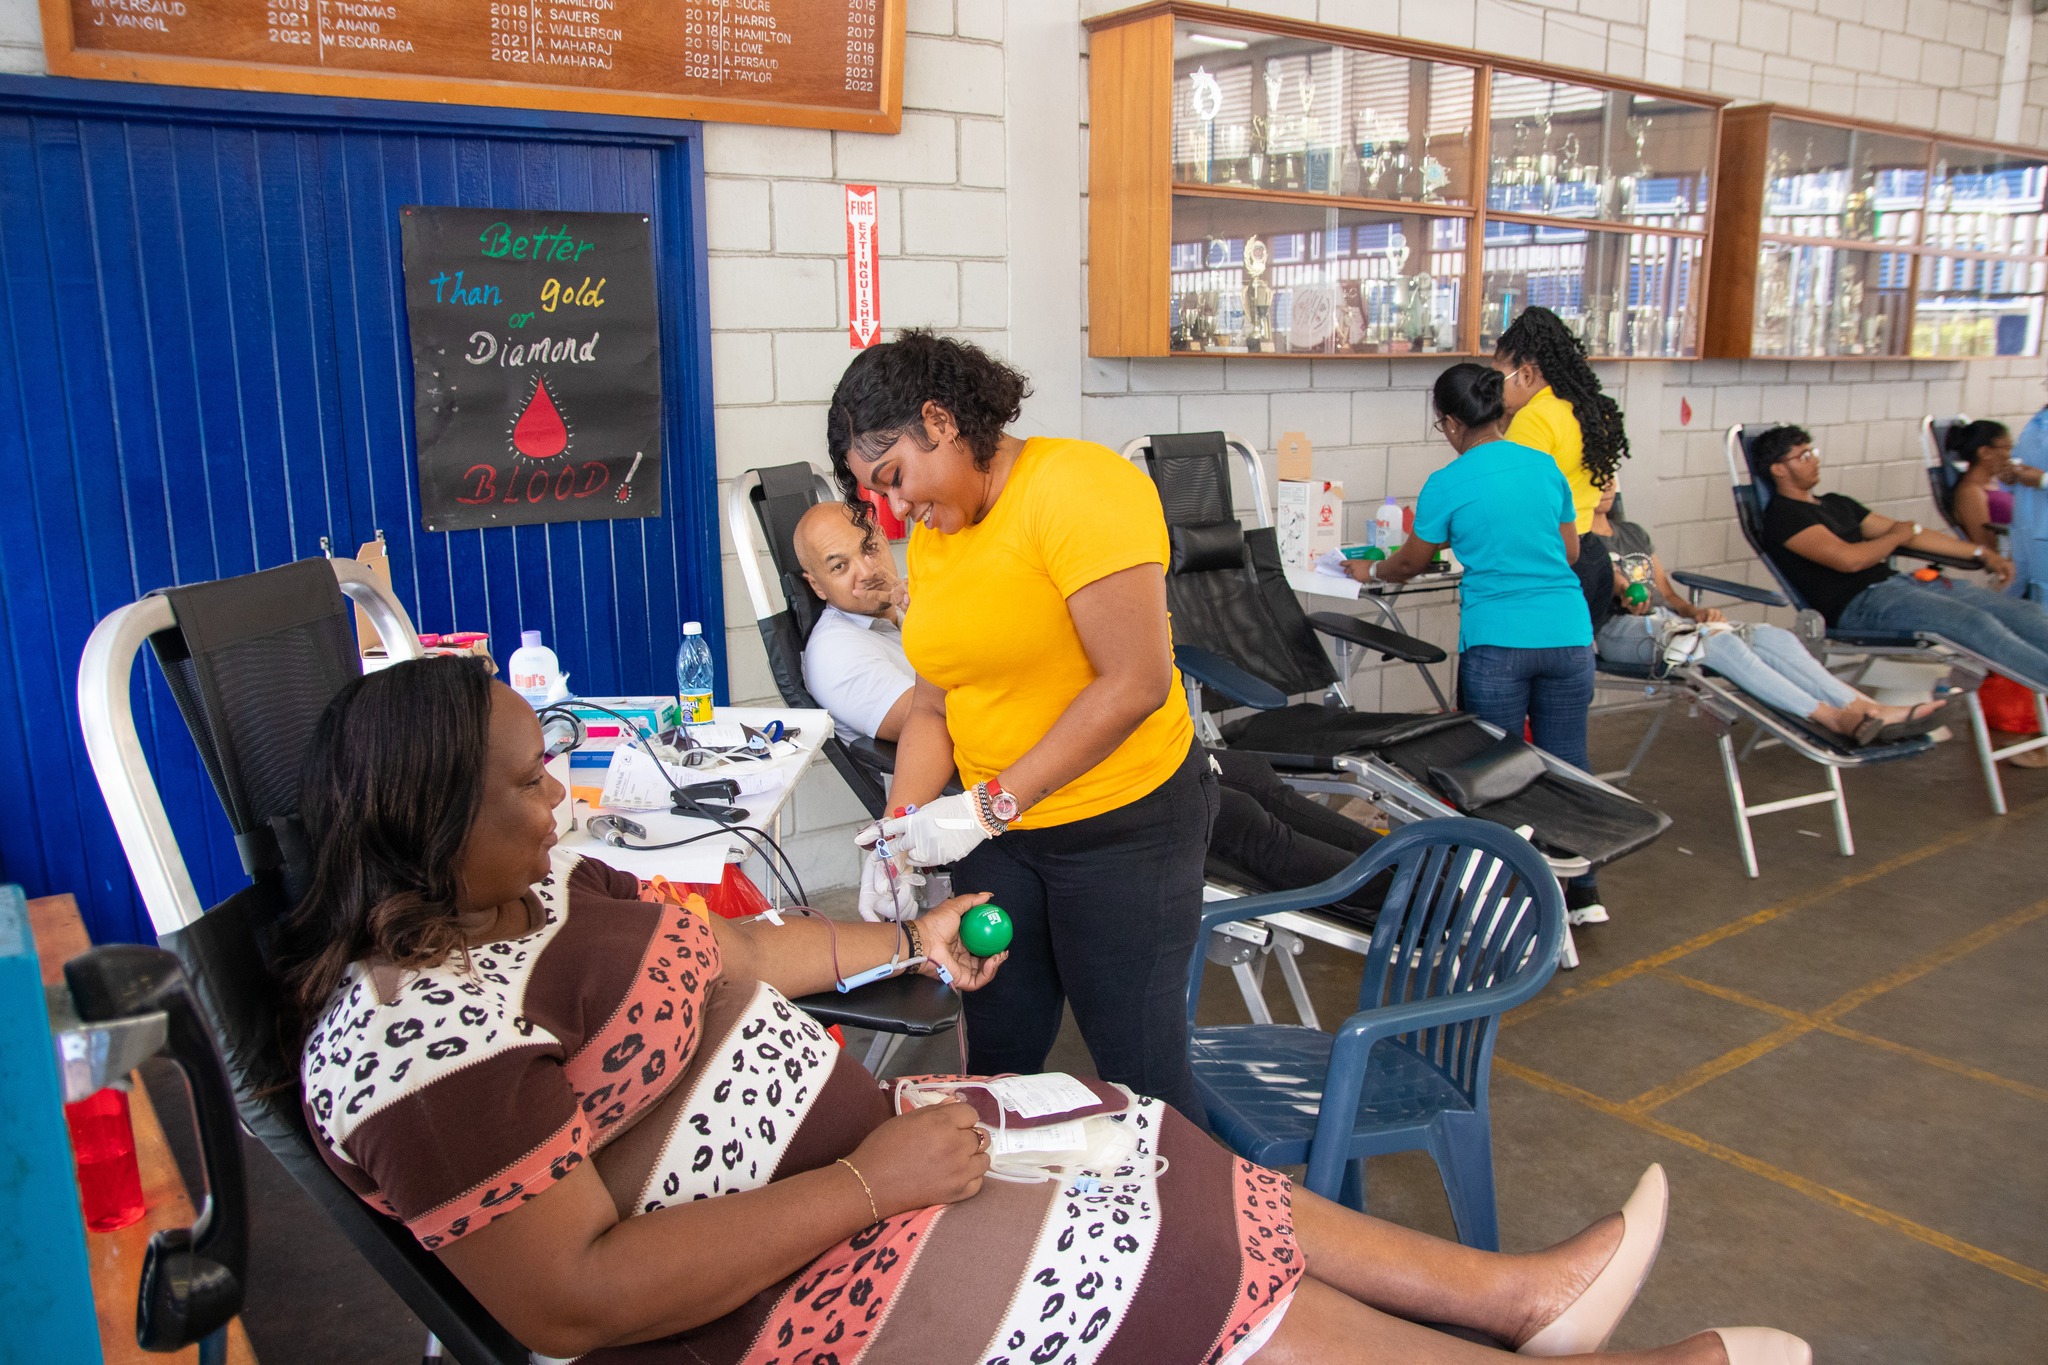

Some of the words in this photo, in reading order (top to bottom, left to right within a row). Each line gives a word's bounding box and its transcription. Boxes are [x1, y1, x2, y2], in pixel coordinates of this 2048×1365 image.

[491, 3, 528, 17] 2018
[848, 0, 876, 11] 2015
[267, 11, 309, 27] 2021
[685, 9, 720, 22] 2017
[848, 12, 875, 26] 2016
[491, 18, 527, 32] 2019
[685, 23, 719, 37] 2018
[268, 28, 311, 45] 2022
[847, 26, 875, 39] 2017
[491, 33, 528, 47] 2021
[685, 37, 719, 51] 2019
[847, 40, 875, 54] 2018
[491, 48, 529, 63] 2022
[685, 51, 718, 65] 2021
[846, 53, 875, 66] 2019
[685, 65, 719, 79] 2022
[846, 67, 873, 79] 2021
[845, 79, 873, 92] 2022
[851, 200, 873, 216] FIRE
[479, 221, 595, 262] Better
[858, 221, 870, 337] EXTINGUISHER
[541, 276, 607, 312] gold
[508, 312, 535, 328] or
[465, 331, 600, 367] Diamond
